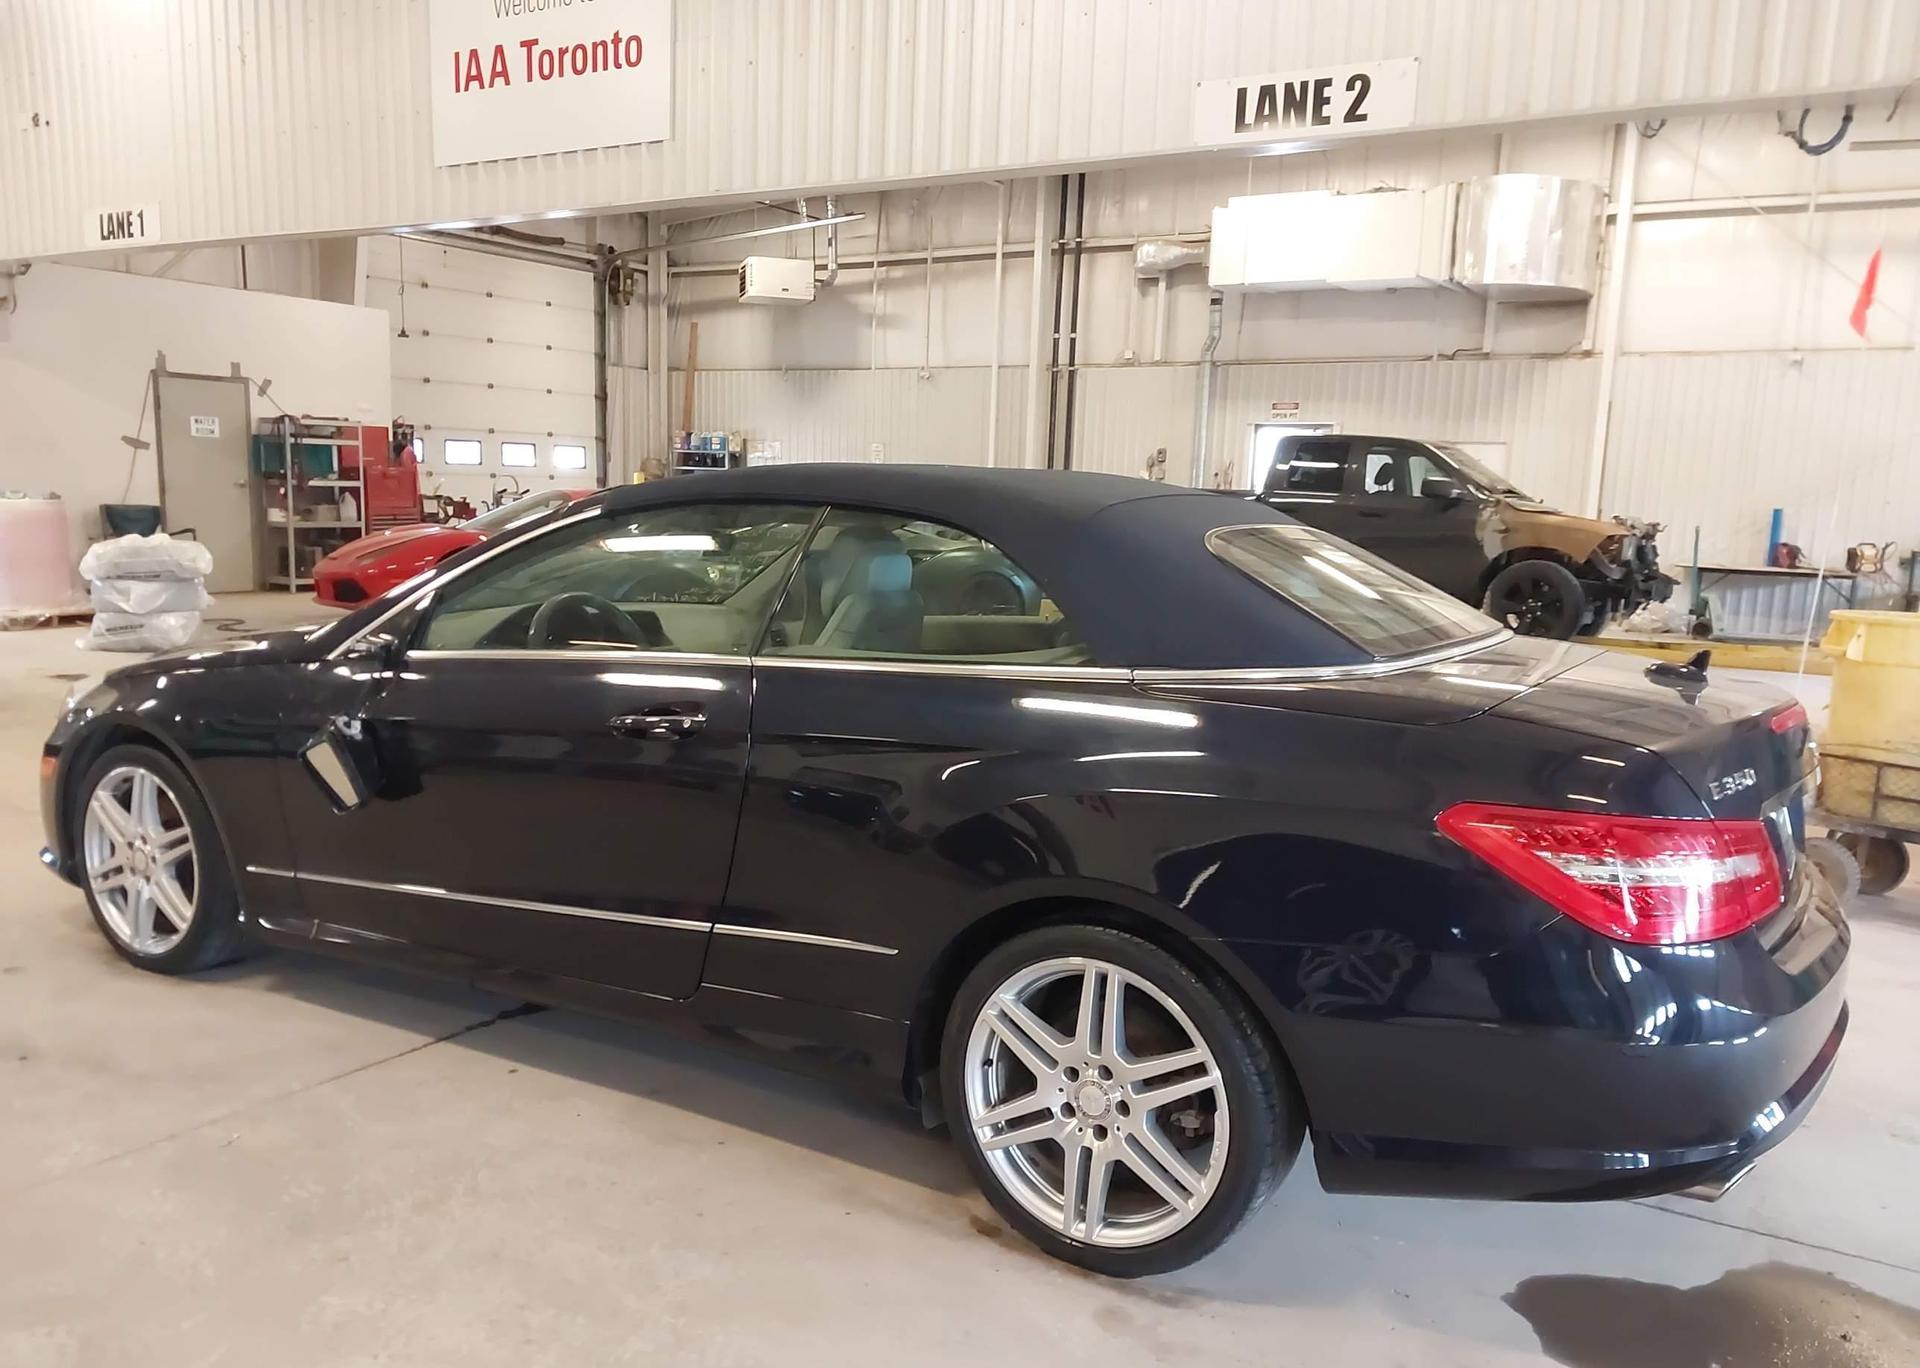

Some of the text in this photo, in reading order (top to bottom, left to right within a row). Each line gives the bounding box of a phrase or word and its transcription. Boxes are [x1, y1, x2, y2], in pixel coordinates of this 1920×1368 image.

[453, 30, 643, 93] IAA Toronto
[1234, 73, 1371, 133] LANE 2
[99, 209, 144, 241] LANE 1
